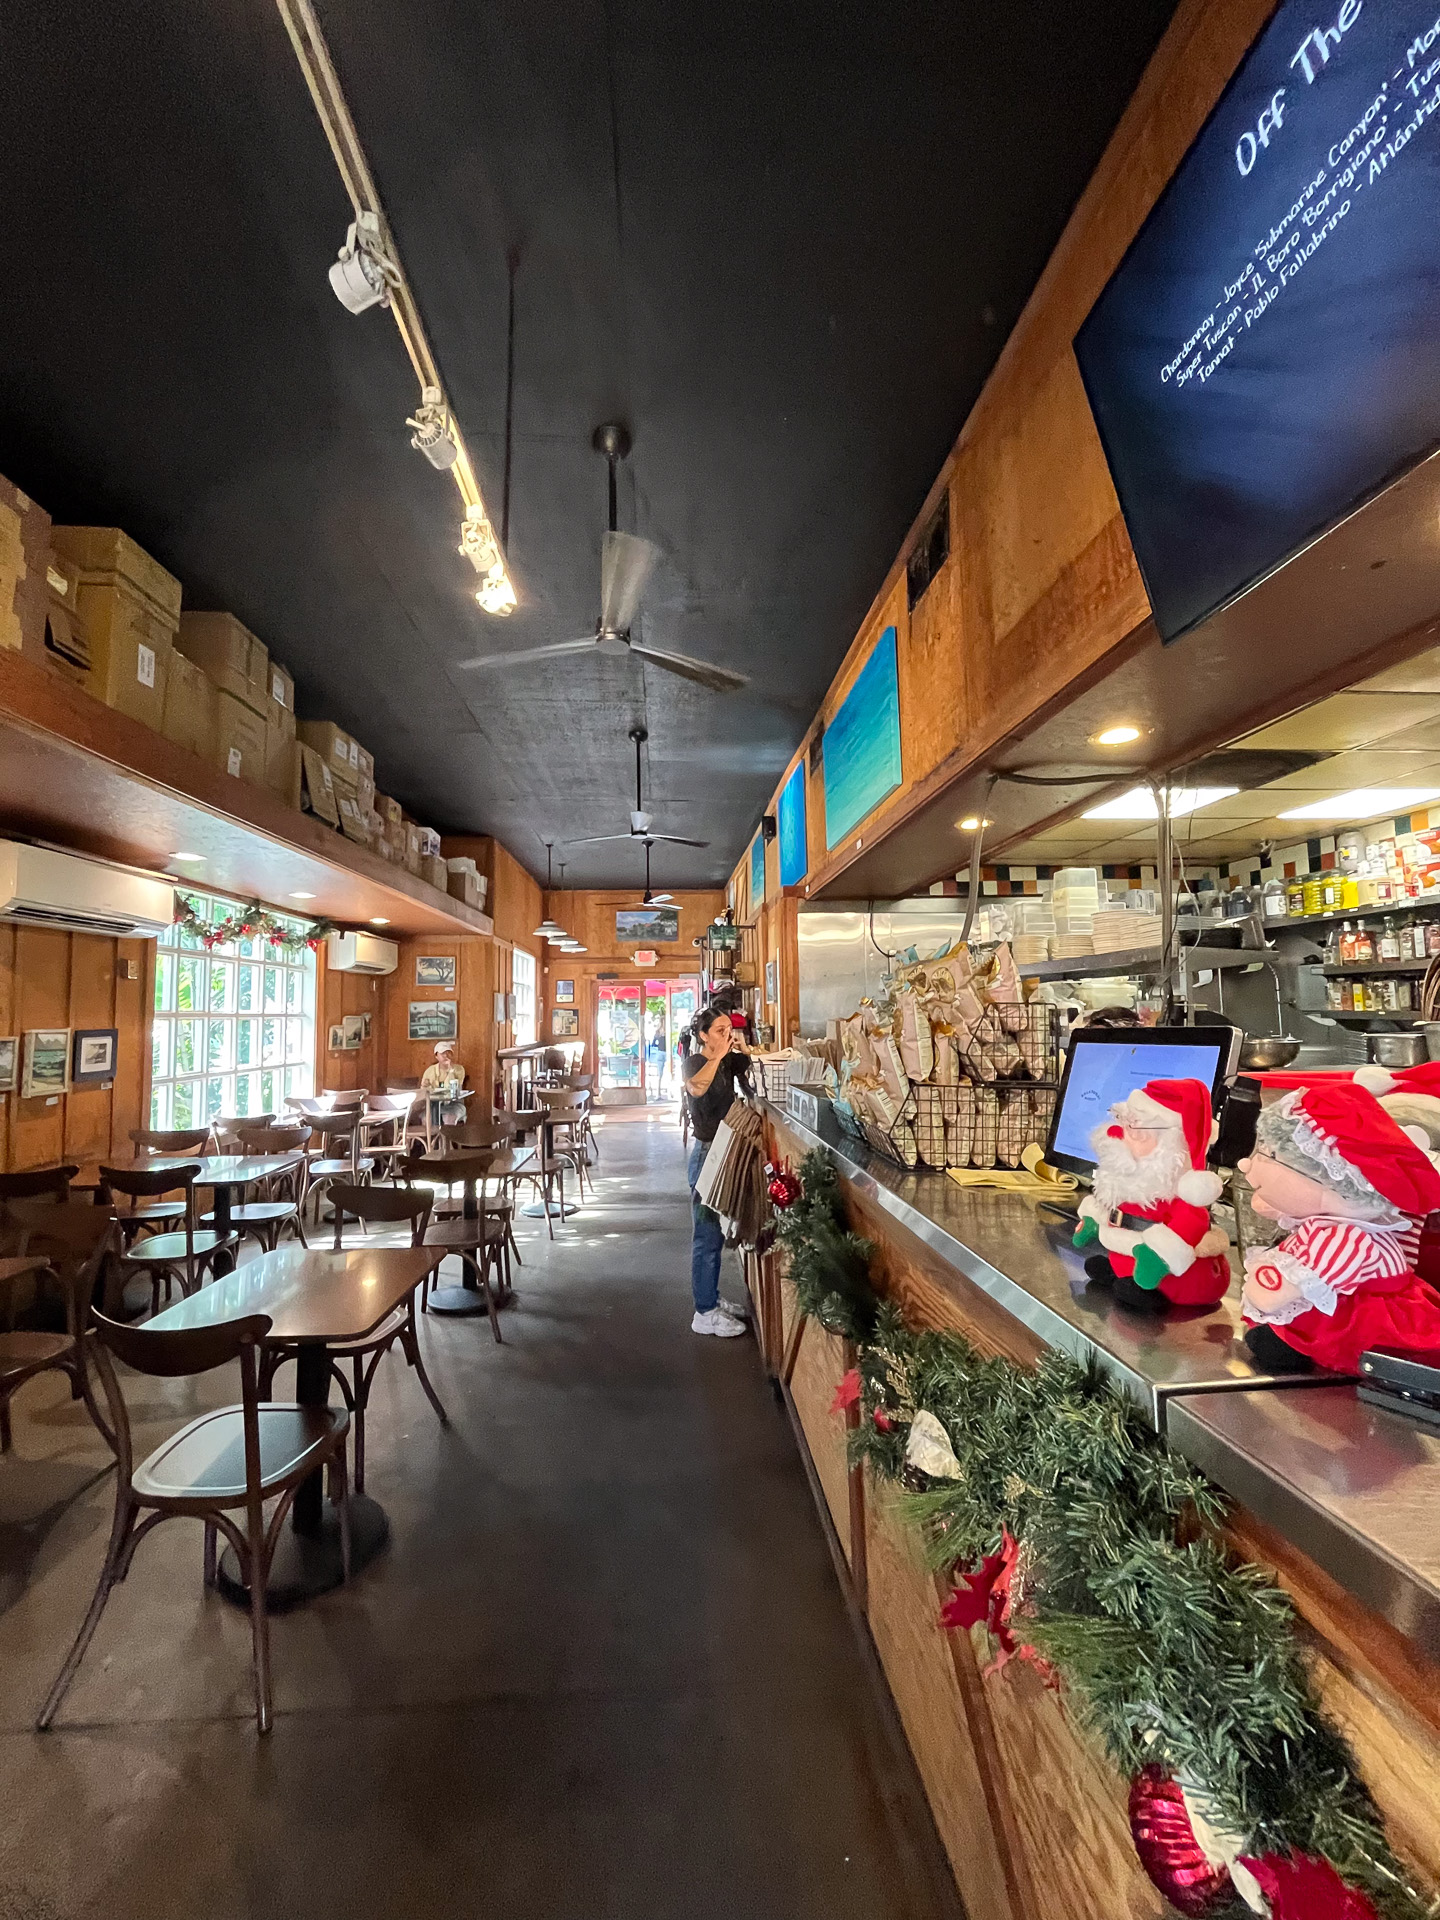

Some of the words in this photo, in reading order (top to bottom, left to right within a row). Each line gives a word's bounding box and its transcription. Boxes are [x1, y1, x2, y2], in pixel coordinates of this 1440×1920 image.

[1235, 88, 1286, 176] Off
[1289, 0, 1363, 85] The
[1160, 313, 1215, 383] Chardonnay
[1224, 263, 1255, 304] Joyce
[1176, 351, 1202, 388] Super
[1202, 305, 1242, 351] Tuscan
[1266, 231, 1301, 273] Boro
[1197, 335, 1235, 383] Tannat
[1244, 285, 1279, 328] Pablo
[1279, 199, 1351, 287] Fallabrino
